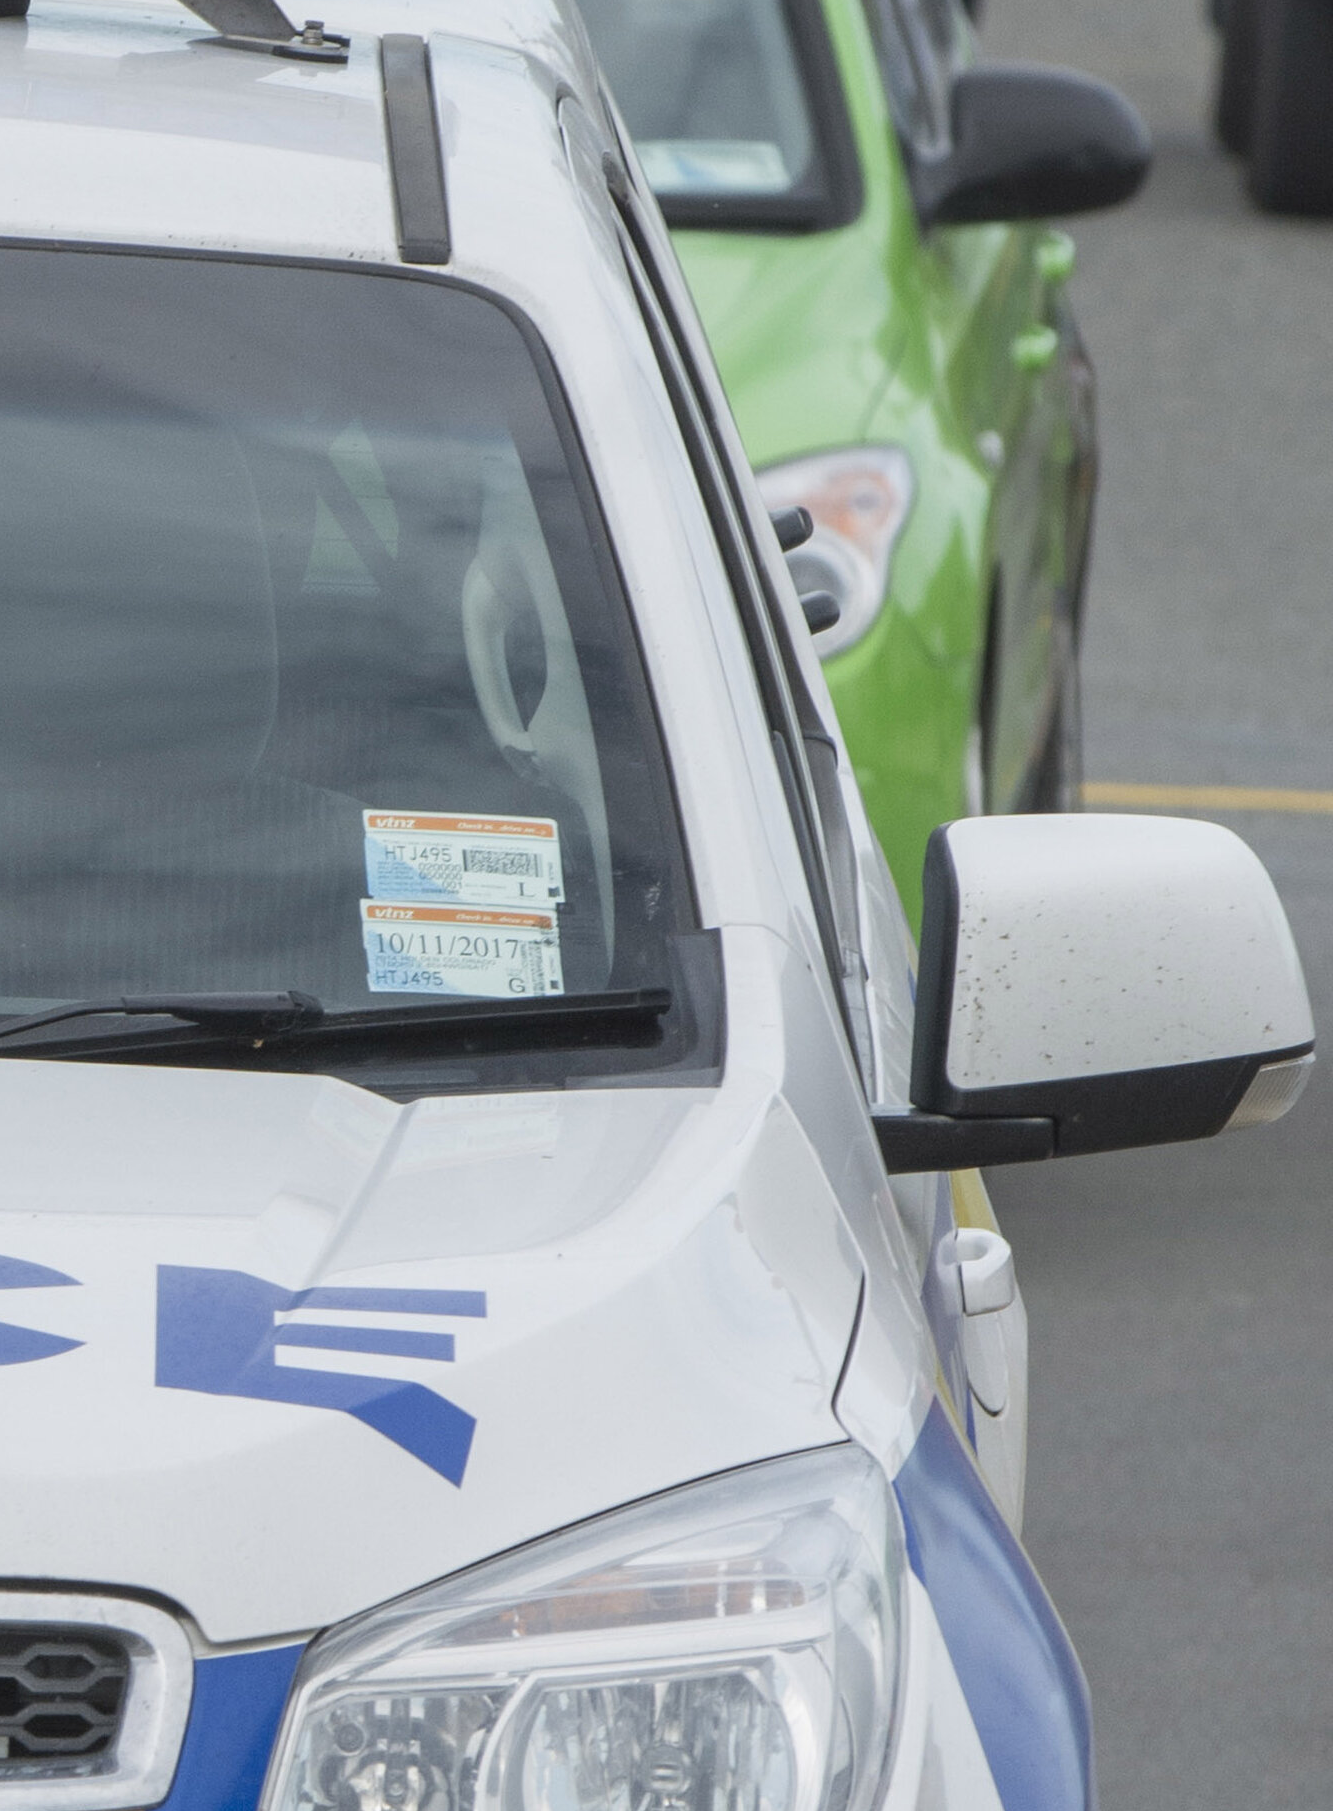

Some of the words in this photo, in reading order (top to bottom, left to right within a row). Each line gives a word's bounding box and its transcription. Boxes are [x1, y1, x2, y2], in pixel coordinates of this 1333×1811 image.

[376, 816, 416, 829] vtnz
[385, 845, 452, 862] HTJ495
[374, 907, 414, 920] vtnz
[377, 932, 519, 959] 10/11/2017
[376, 970, 443, 985] HTJ495
